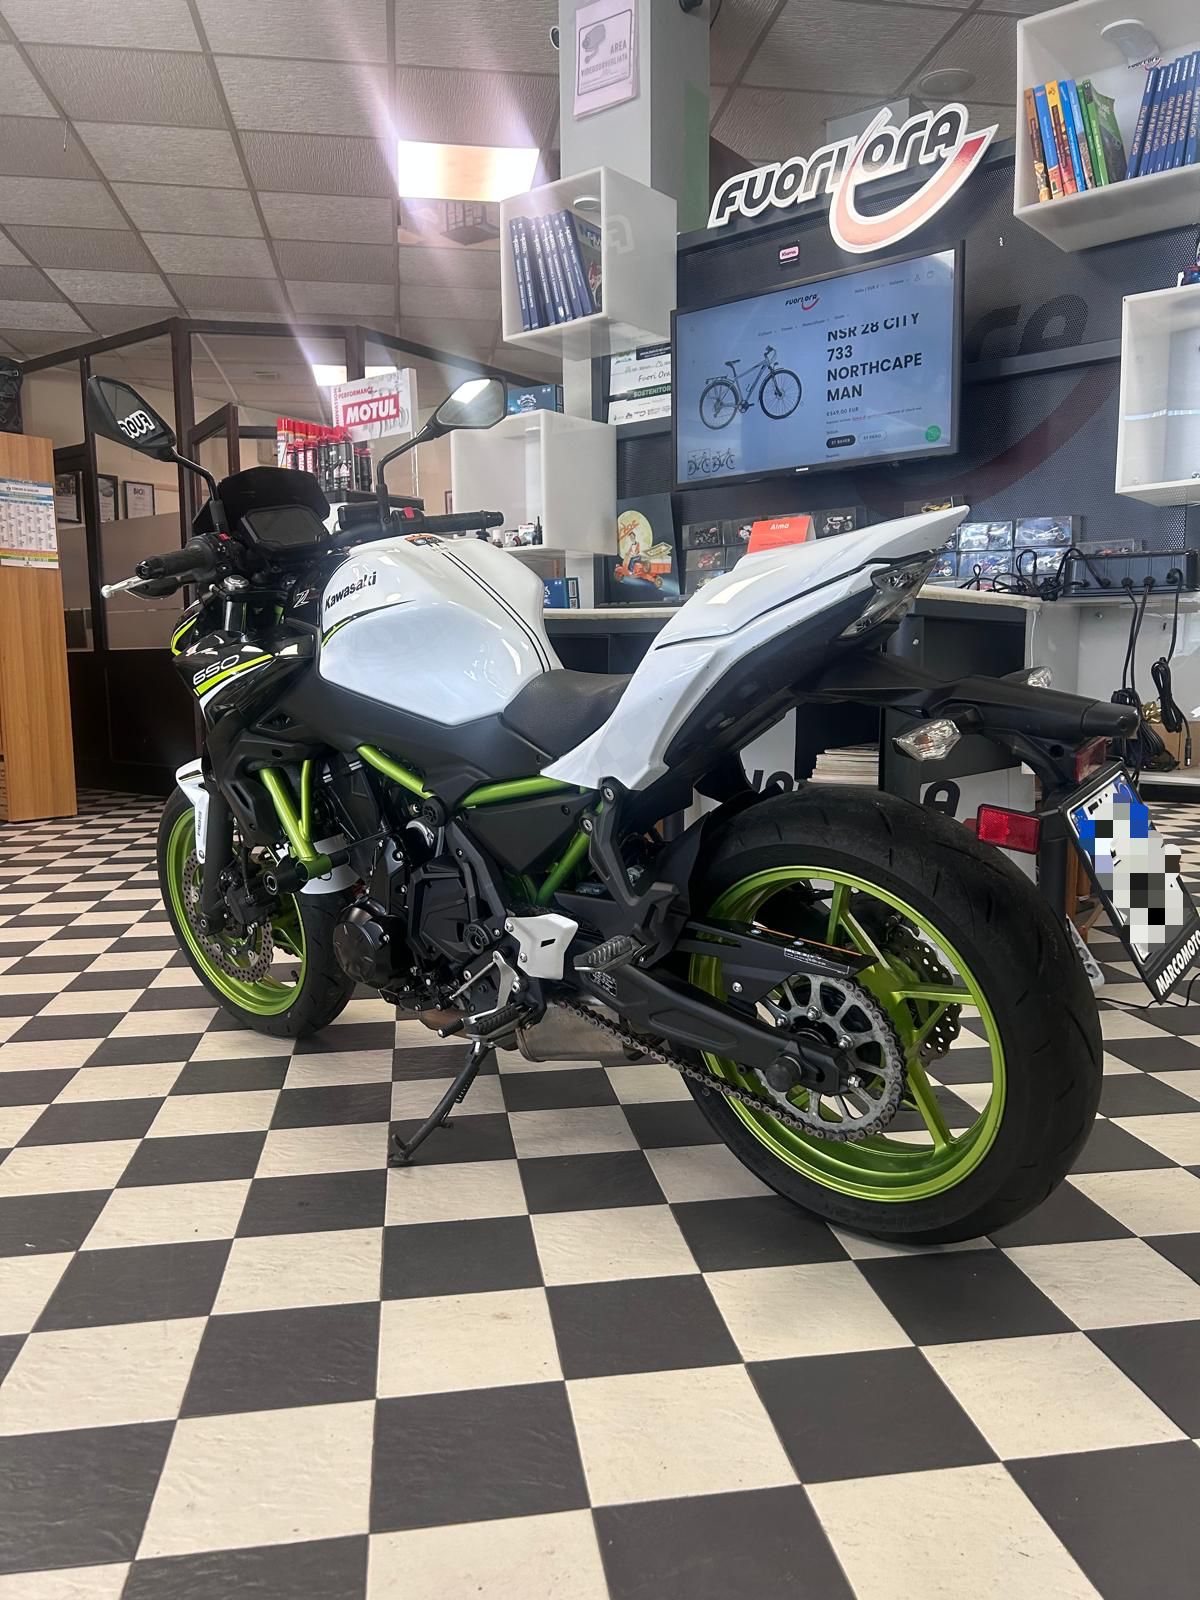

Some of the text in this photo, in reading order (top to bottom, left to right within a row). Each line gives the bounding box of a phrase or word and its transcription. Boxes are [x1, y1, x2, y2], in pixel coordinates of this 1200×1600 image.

[610, 40, 627, 54] AREA
[827, 326, 857, 342] NSR
[827, 344, 853, 362] 733
[827, 352, 922, 382] NORTHCAPE
[633, 385, 671, 398] SOSTENITOR
[827, 384, 863, 403] MAN
[345, 398, 397, 425] MOTUL
[325, 571, 377, 612] Kawasaki
[192, 654, 240, 686] 650
